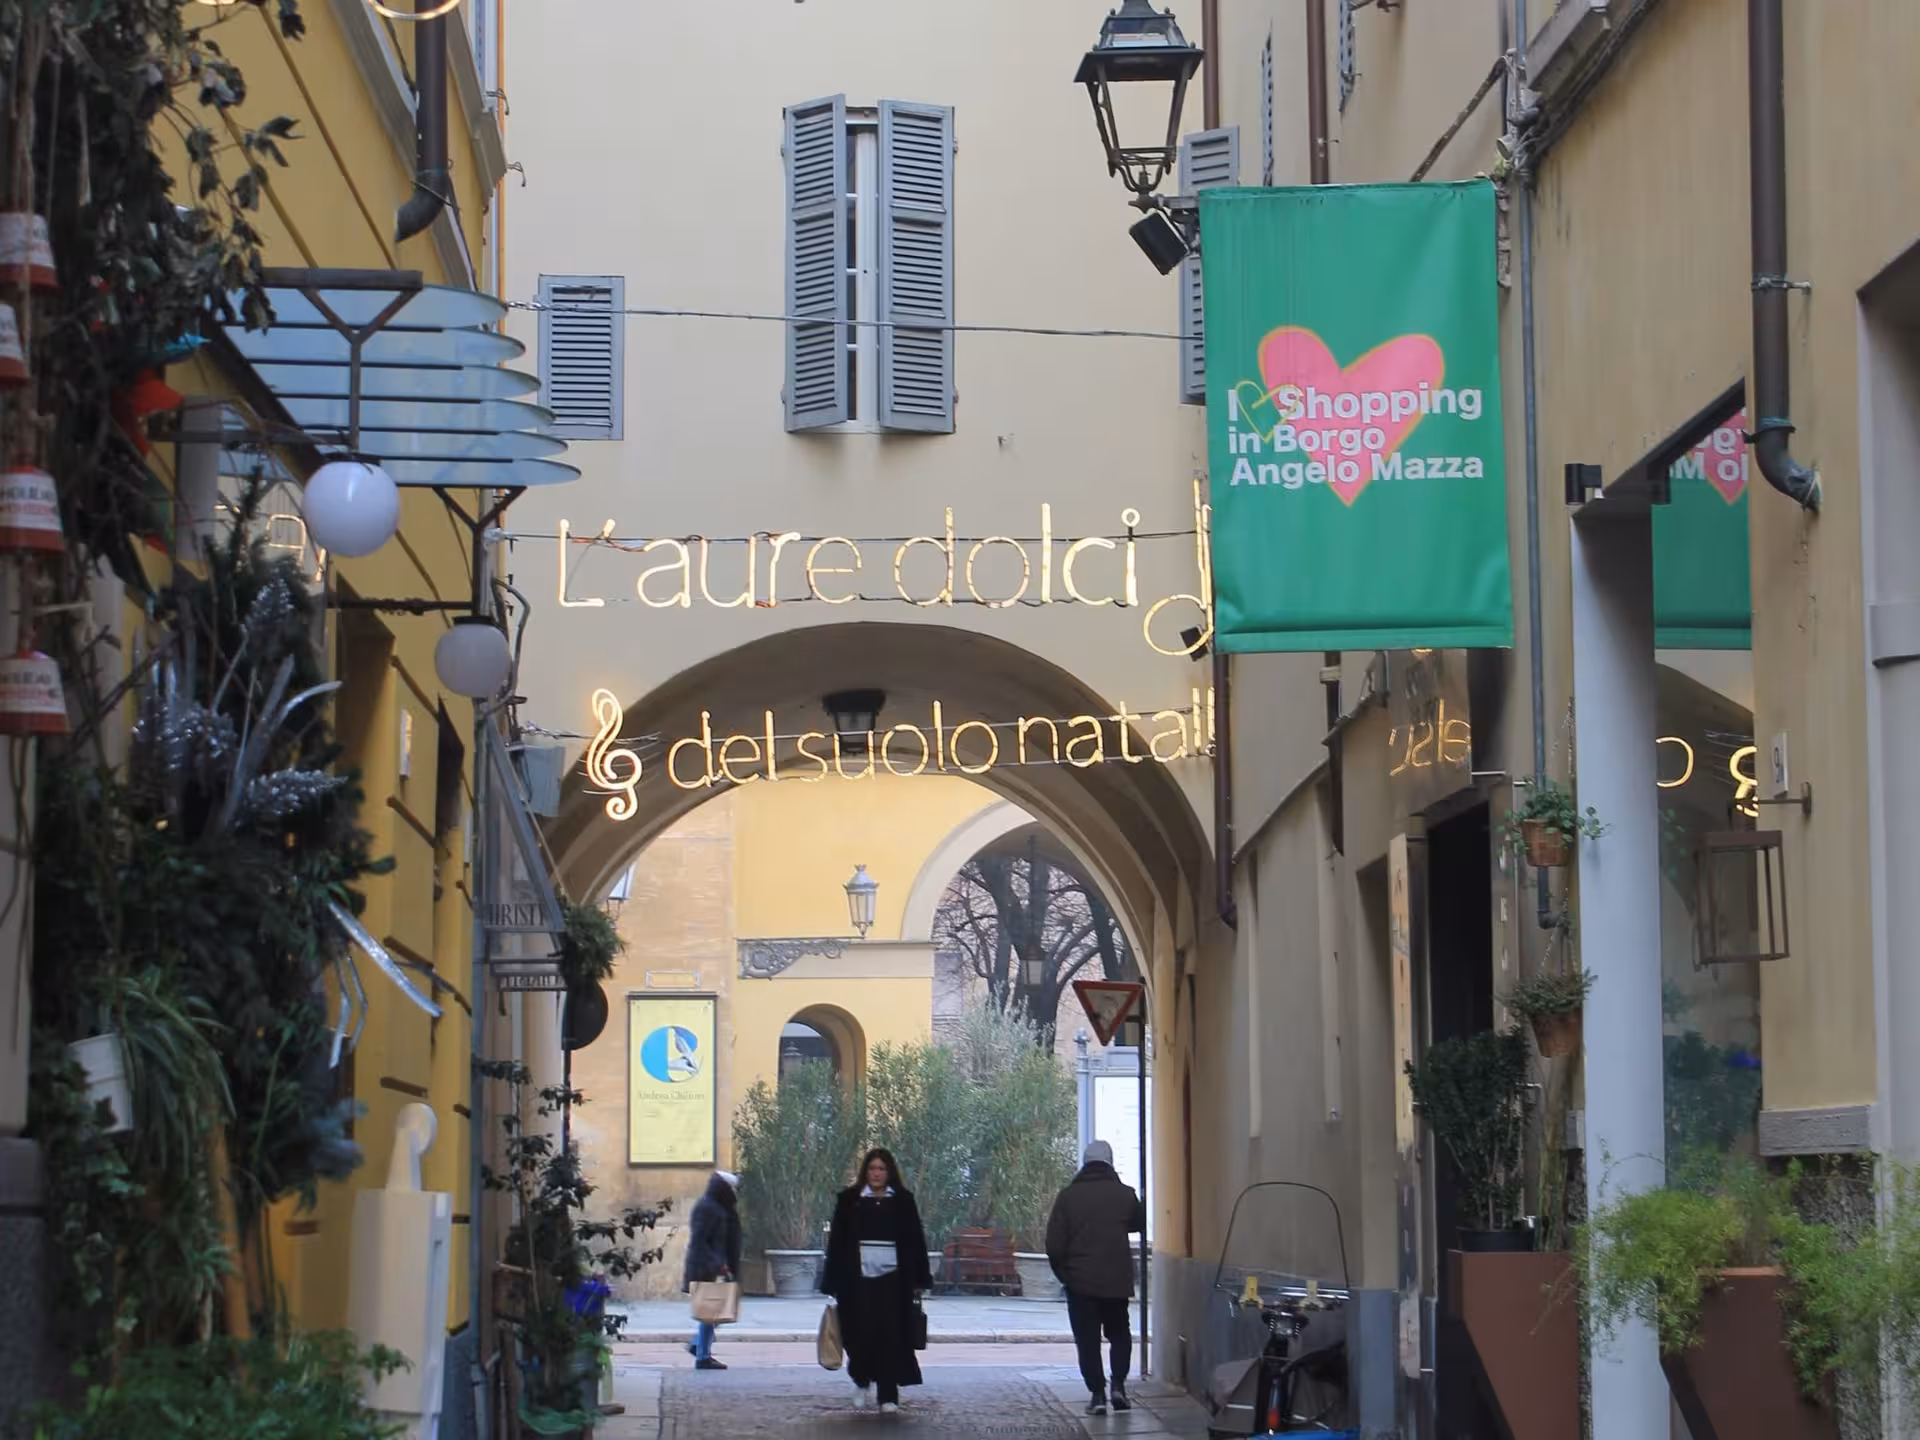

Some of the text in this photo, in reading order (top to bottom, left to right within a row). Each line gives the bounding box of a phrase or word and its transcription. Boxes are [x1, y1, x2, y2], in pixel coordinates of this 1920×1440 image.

[1227, 382, 1482, 424] I Shopping
[1228, 424, 1386, 456] in Borgo
[1229, 451, 1484, 490] Angelo Mazza
[558, 502, 1138, 609] L'aure dolci
[667, 709, 779, 790] del
[797, 700, 999, 783] suolo
